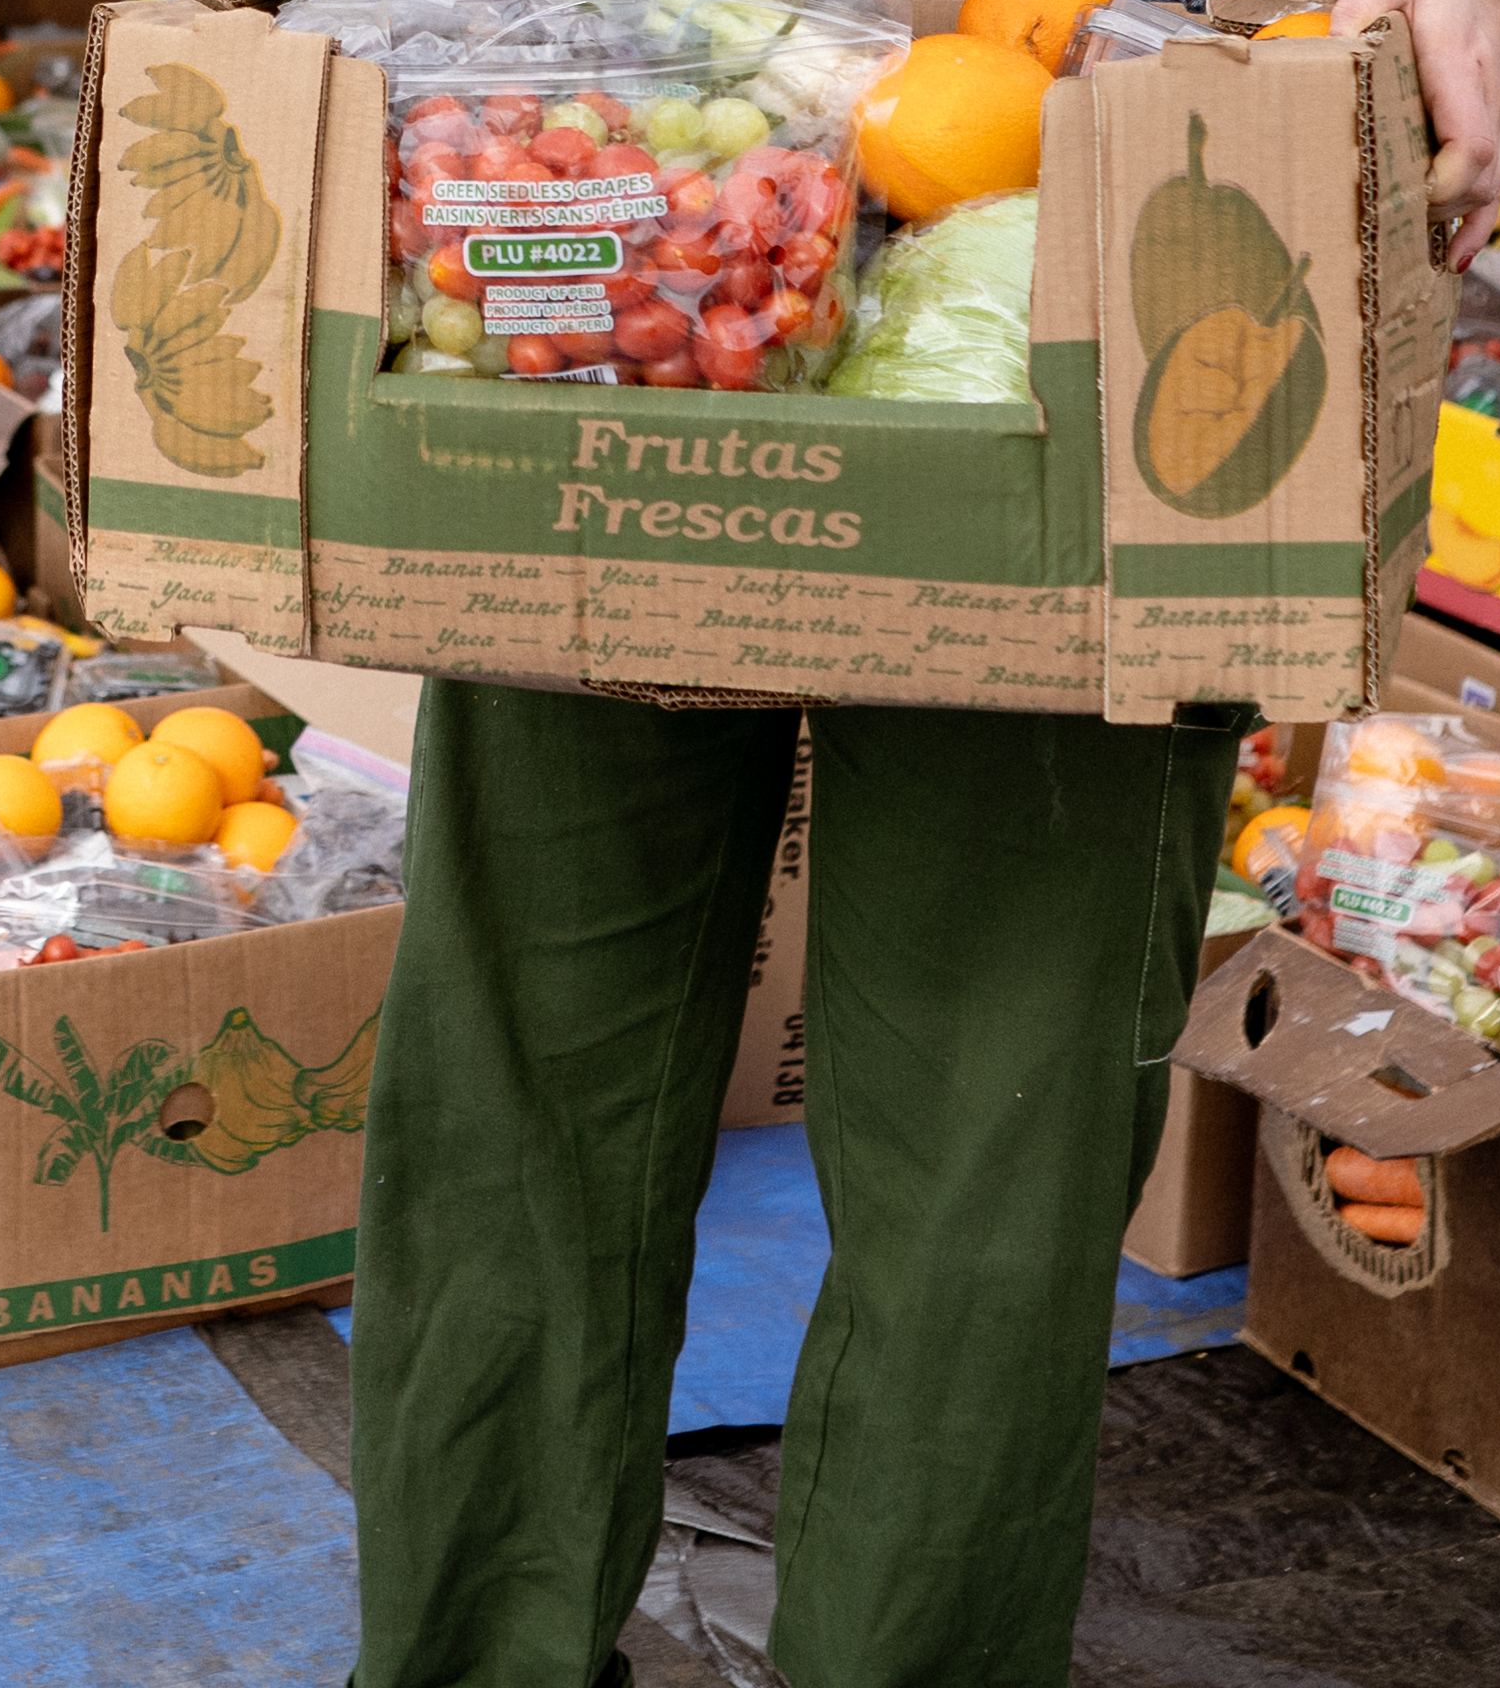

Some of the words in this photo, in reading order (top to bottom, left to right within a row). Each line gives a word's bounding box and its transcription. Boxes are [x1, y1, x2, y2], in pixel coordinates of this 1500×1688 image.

[434, 182, 486, 200] GREEN
[489, 181, 573, 200] SEEDLESS
[576, 175, 652, 198] GRAPES
[424, 206, 485, 224] RAISINS
[488, 208, 541, 224] VERTS
[544, 206, 594, 224] SANS
[597, 198, 667, 222] PÉPINS
[481, 243, 524, 264] PLU
[529, 242, 602, 263] #4022
[488, 286, 547, 300] PRODUCT
[550, 286, 568, 299] OF
[570, 284, 604, 299] PERU
[486, 303, 543, 316] PRODUIT
[545, 304, 563, 316] DU
[565, 301, 611, 315] PÉROU
[485, 320, 556, 333] PRODUCTO
[558, 320, 575, 332] DE
[577, 317, 613, 332] PERÚ
[571, 417, 843, 483] Frutas
[551, 481, 863, 550] Frescas
[588, 565, 660, 595] Yaca
[725, 572, 851, 606] Jackfruit
[149, 580, 217, 610] Yaca
[914, 624, 988, 654] Yaca
[424, 626, 496, 655] Yaca
